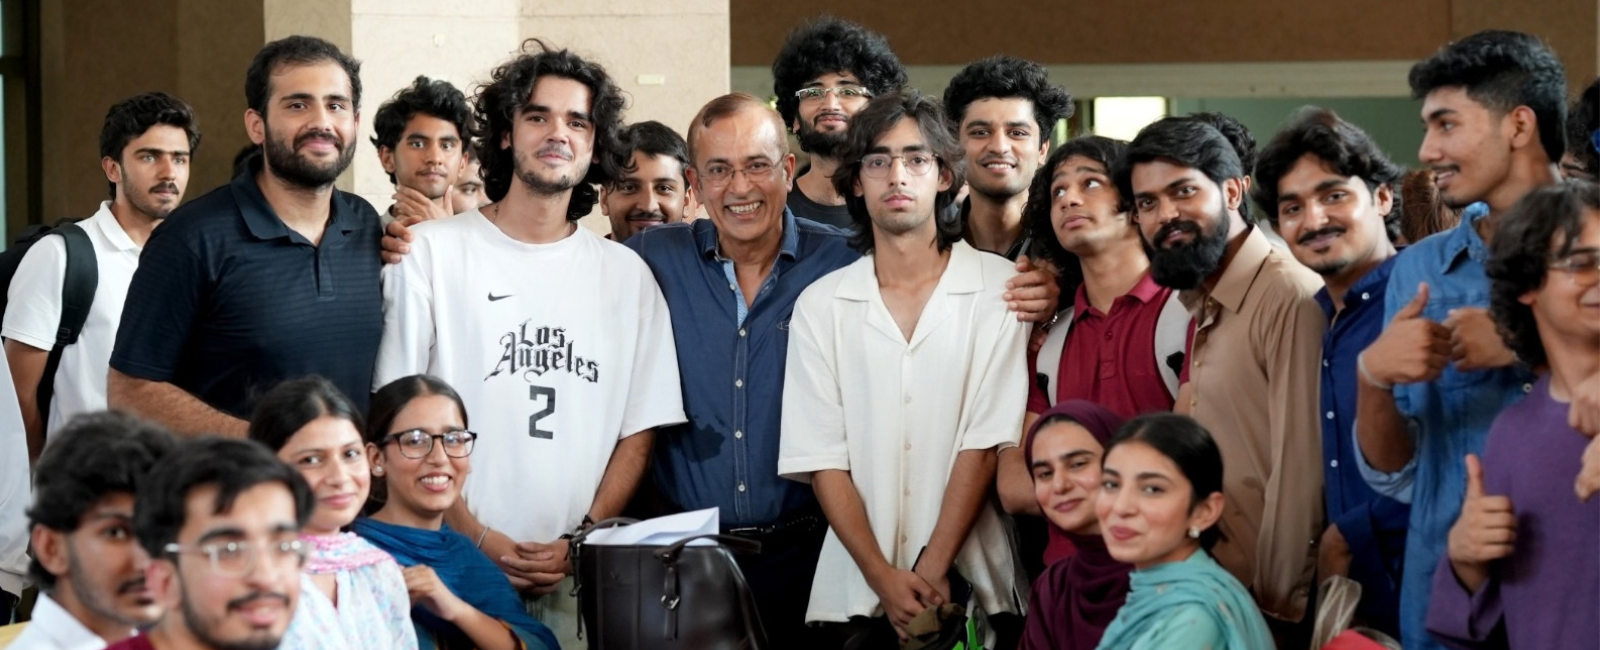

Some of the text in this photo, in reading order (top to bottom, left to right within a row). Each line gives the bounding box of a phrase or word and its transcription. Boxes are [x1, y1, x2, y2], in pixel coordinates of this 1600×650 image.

[484, 331, 599, 383] Angeles
[518, 318, 566, 349] Los
[529, 385, 556, 440] 2
